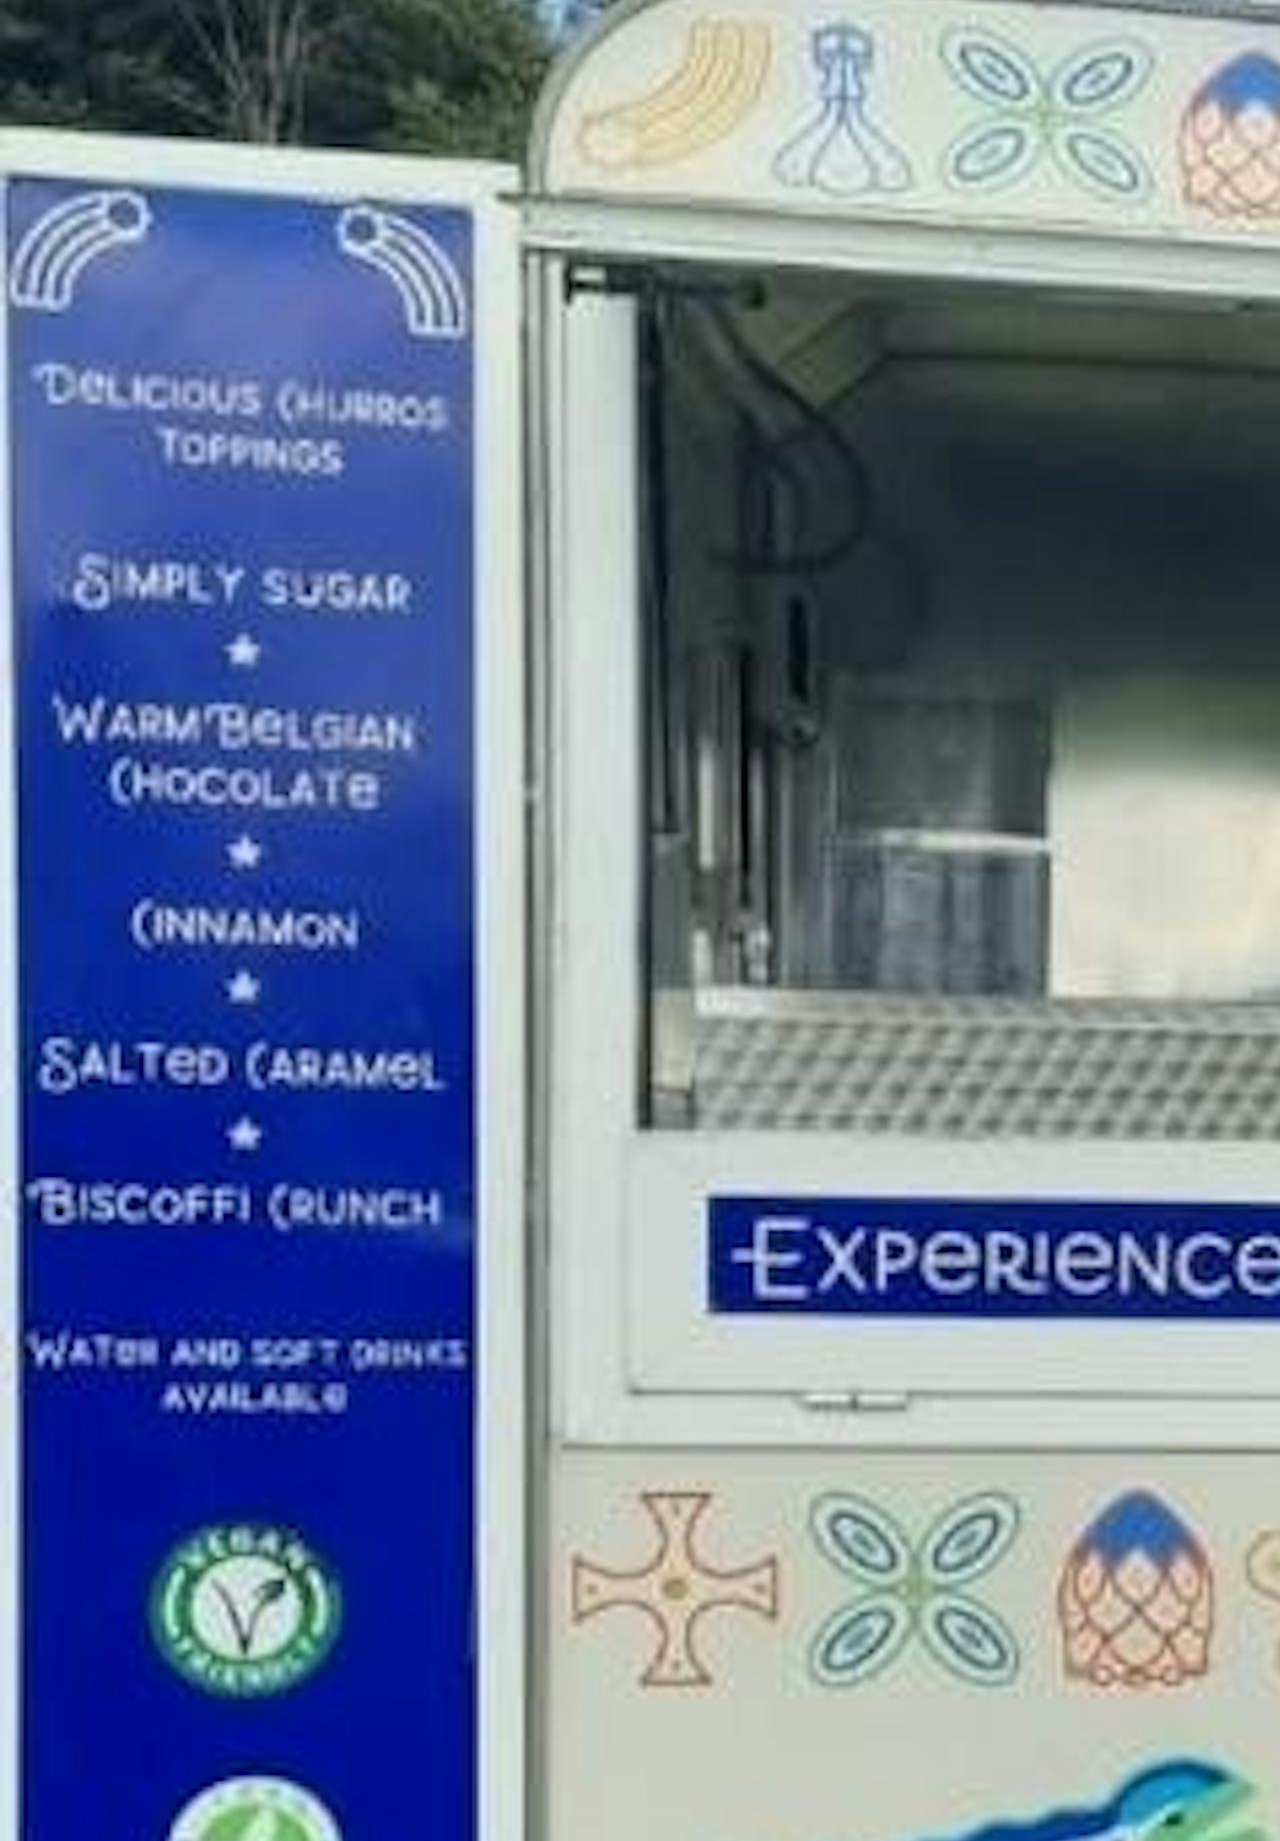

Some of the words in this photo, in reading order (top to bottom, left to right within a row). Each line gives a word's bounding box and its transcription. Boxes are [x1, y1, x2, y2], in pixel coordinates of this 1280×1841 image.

[156, 426, 344, 476] TOPPINGS
[72, 552, 246, 611] SIMPLY
[261, 567, 413, 613] SUGAR
[52, 692, 200, 744] WARM
[109, 757, 380, 810] CHOCOLATE
[132, 898, 360, 950] CINNAMON
[40, 1036, 230, 1094] SALTED
[244, 1040, 447, 1091] CARAMEL
[267, 1182, 441, 1230] CRUNCH
[169, 1338, 241, 1367] AND
